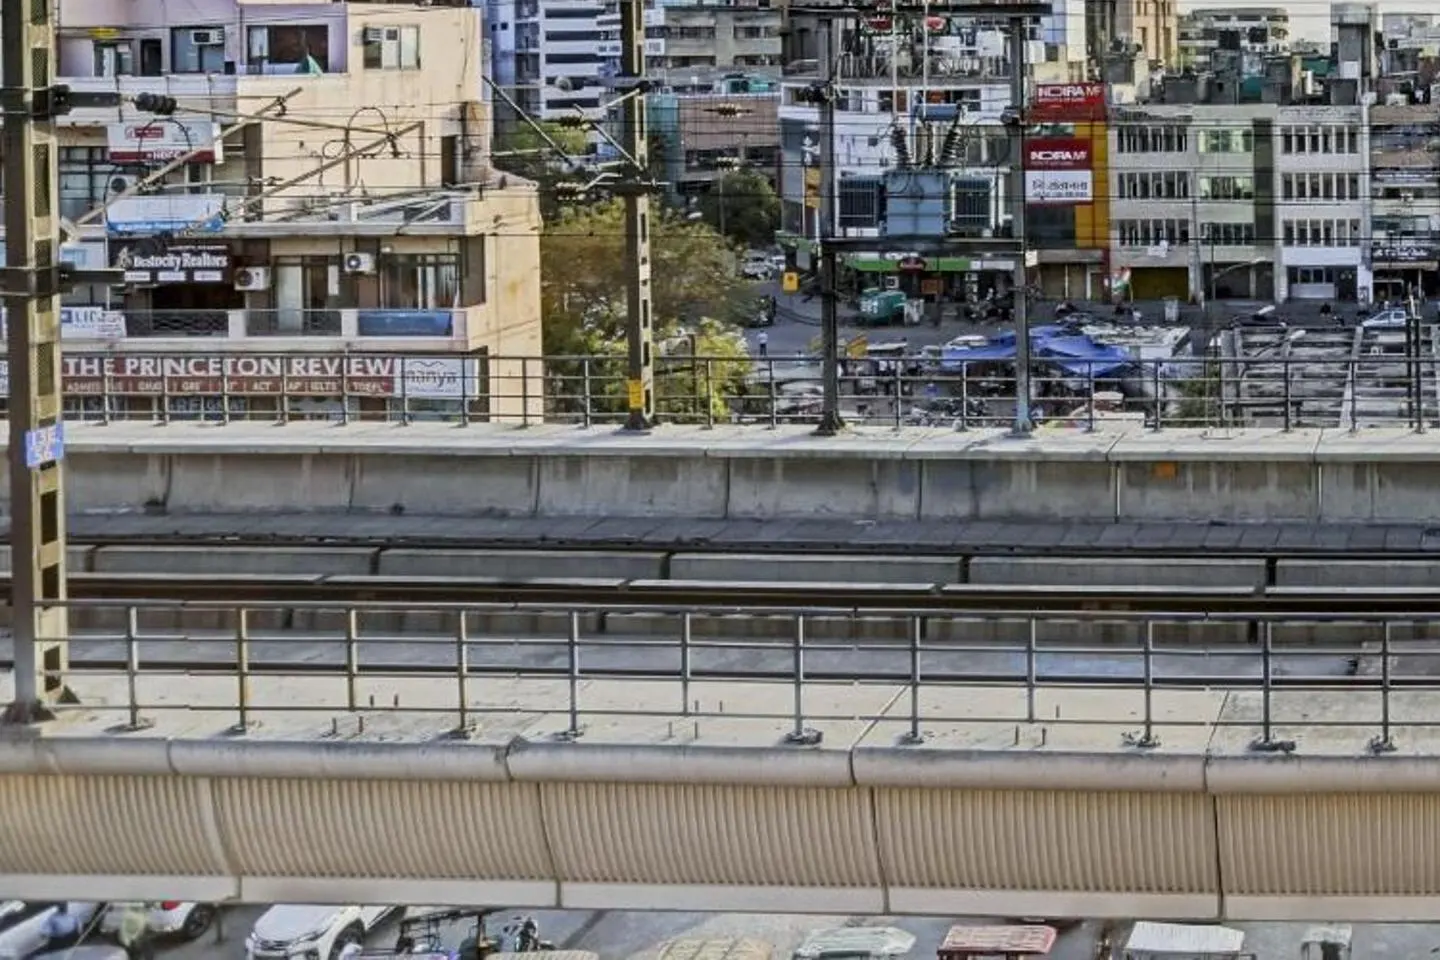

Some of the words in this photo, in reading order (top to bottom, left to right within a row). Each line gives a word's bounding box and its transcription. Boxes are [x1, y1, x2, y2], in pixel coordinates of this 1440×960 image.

[181, 252, 228, 268] Realtors
[64, 358, 115, 376] THE
[126, 358, 281, 376] PRINCETON
[292, 358, 392, 376] REVIEW
